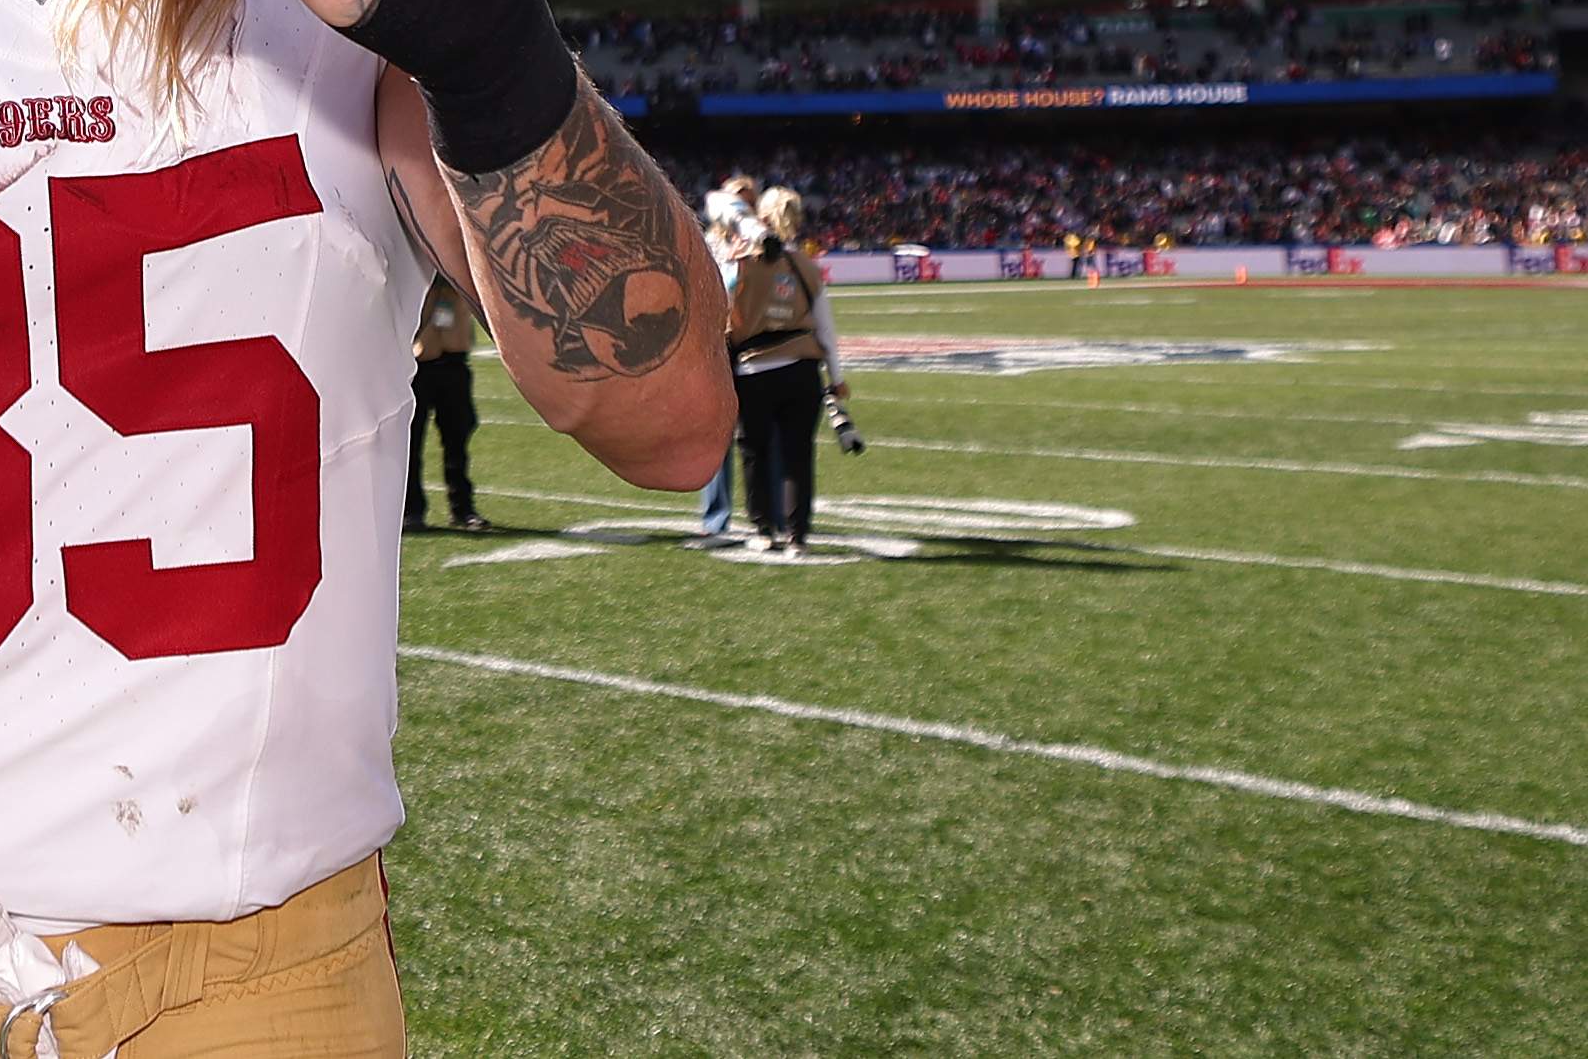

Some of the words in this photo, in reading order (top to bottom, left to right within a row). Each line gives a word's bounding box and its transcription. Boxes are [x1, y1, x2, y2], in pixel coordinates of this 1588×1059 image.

[945, 93, 1020, 109] WHOSE
[1024, 89, 1104, 107] HOUSE?
[1110, 84, 1172, 105] RAMS
[1176, 82, 1248, 104] HOUSE
